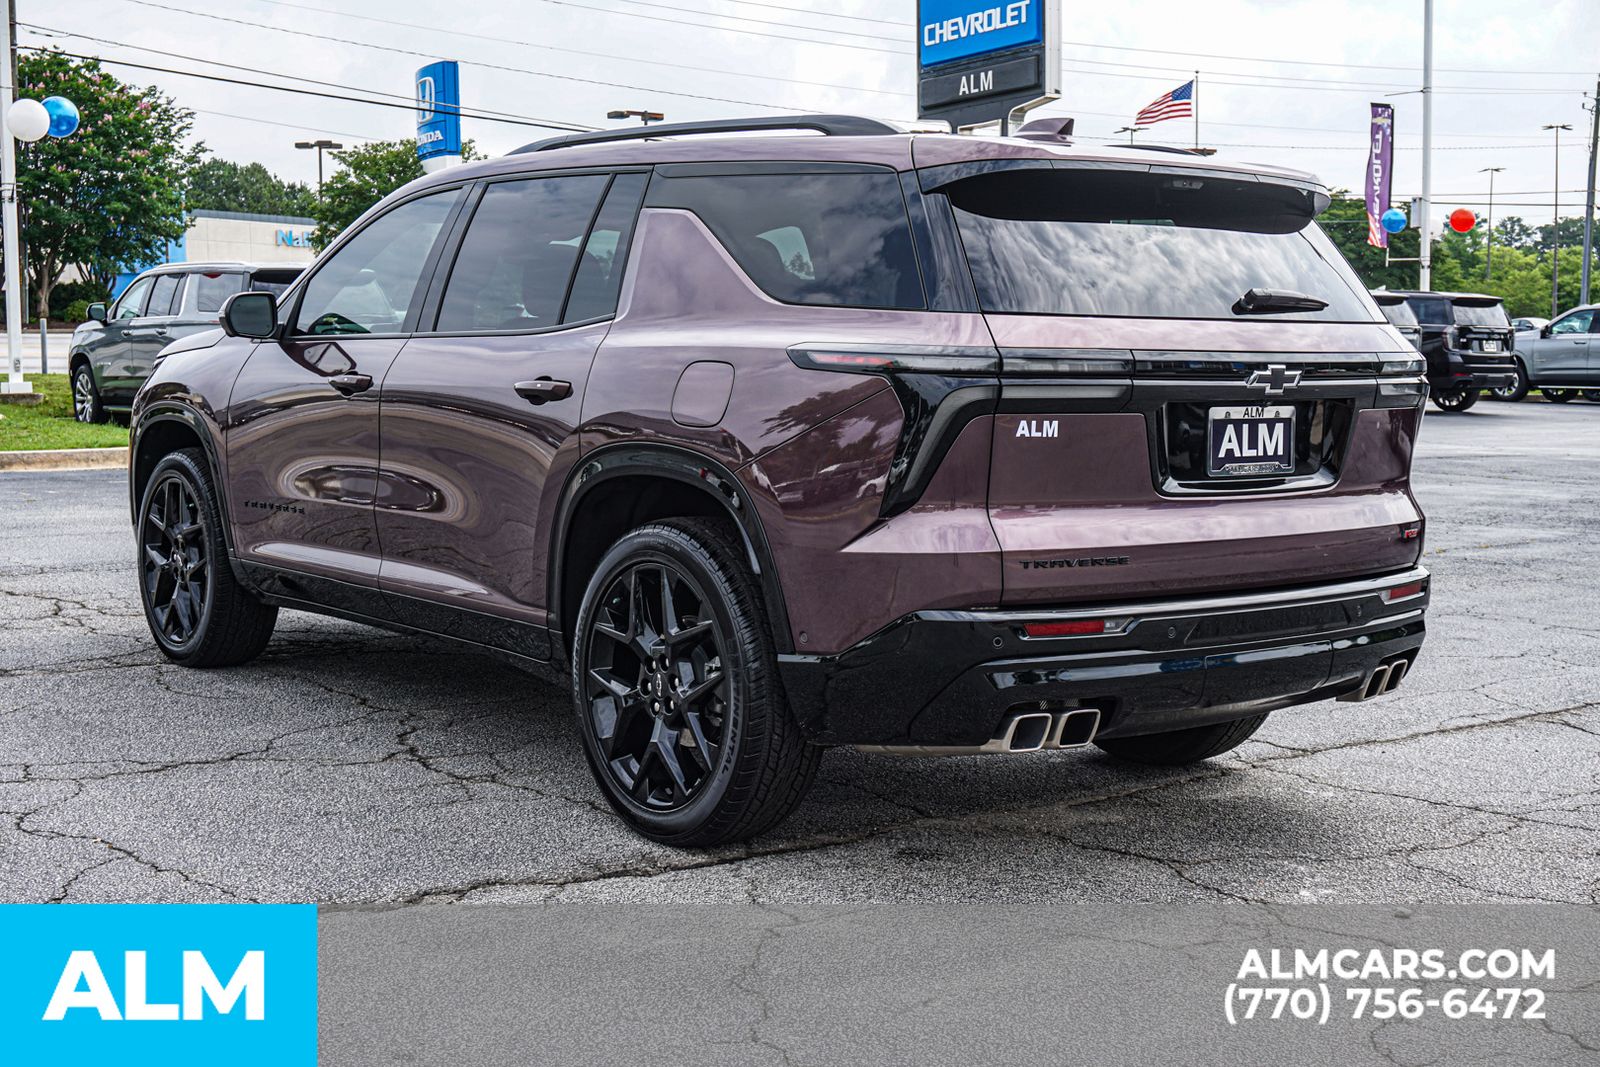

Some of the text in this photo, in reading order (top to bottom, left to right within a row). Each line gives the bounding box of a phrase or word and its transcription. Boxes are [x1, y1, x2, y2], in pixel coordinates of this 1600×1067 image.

[924, 0, 1031, 47] CHEVROLET
[958, 69, 993, 96] ALM
[1243, 407, 1265, 418] ALM
[1015, 420, 1059, 438] ALM
[1218, 422, 1284, 458] ALM
[1019, 556, 1130, 570] TRAVERSE
